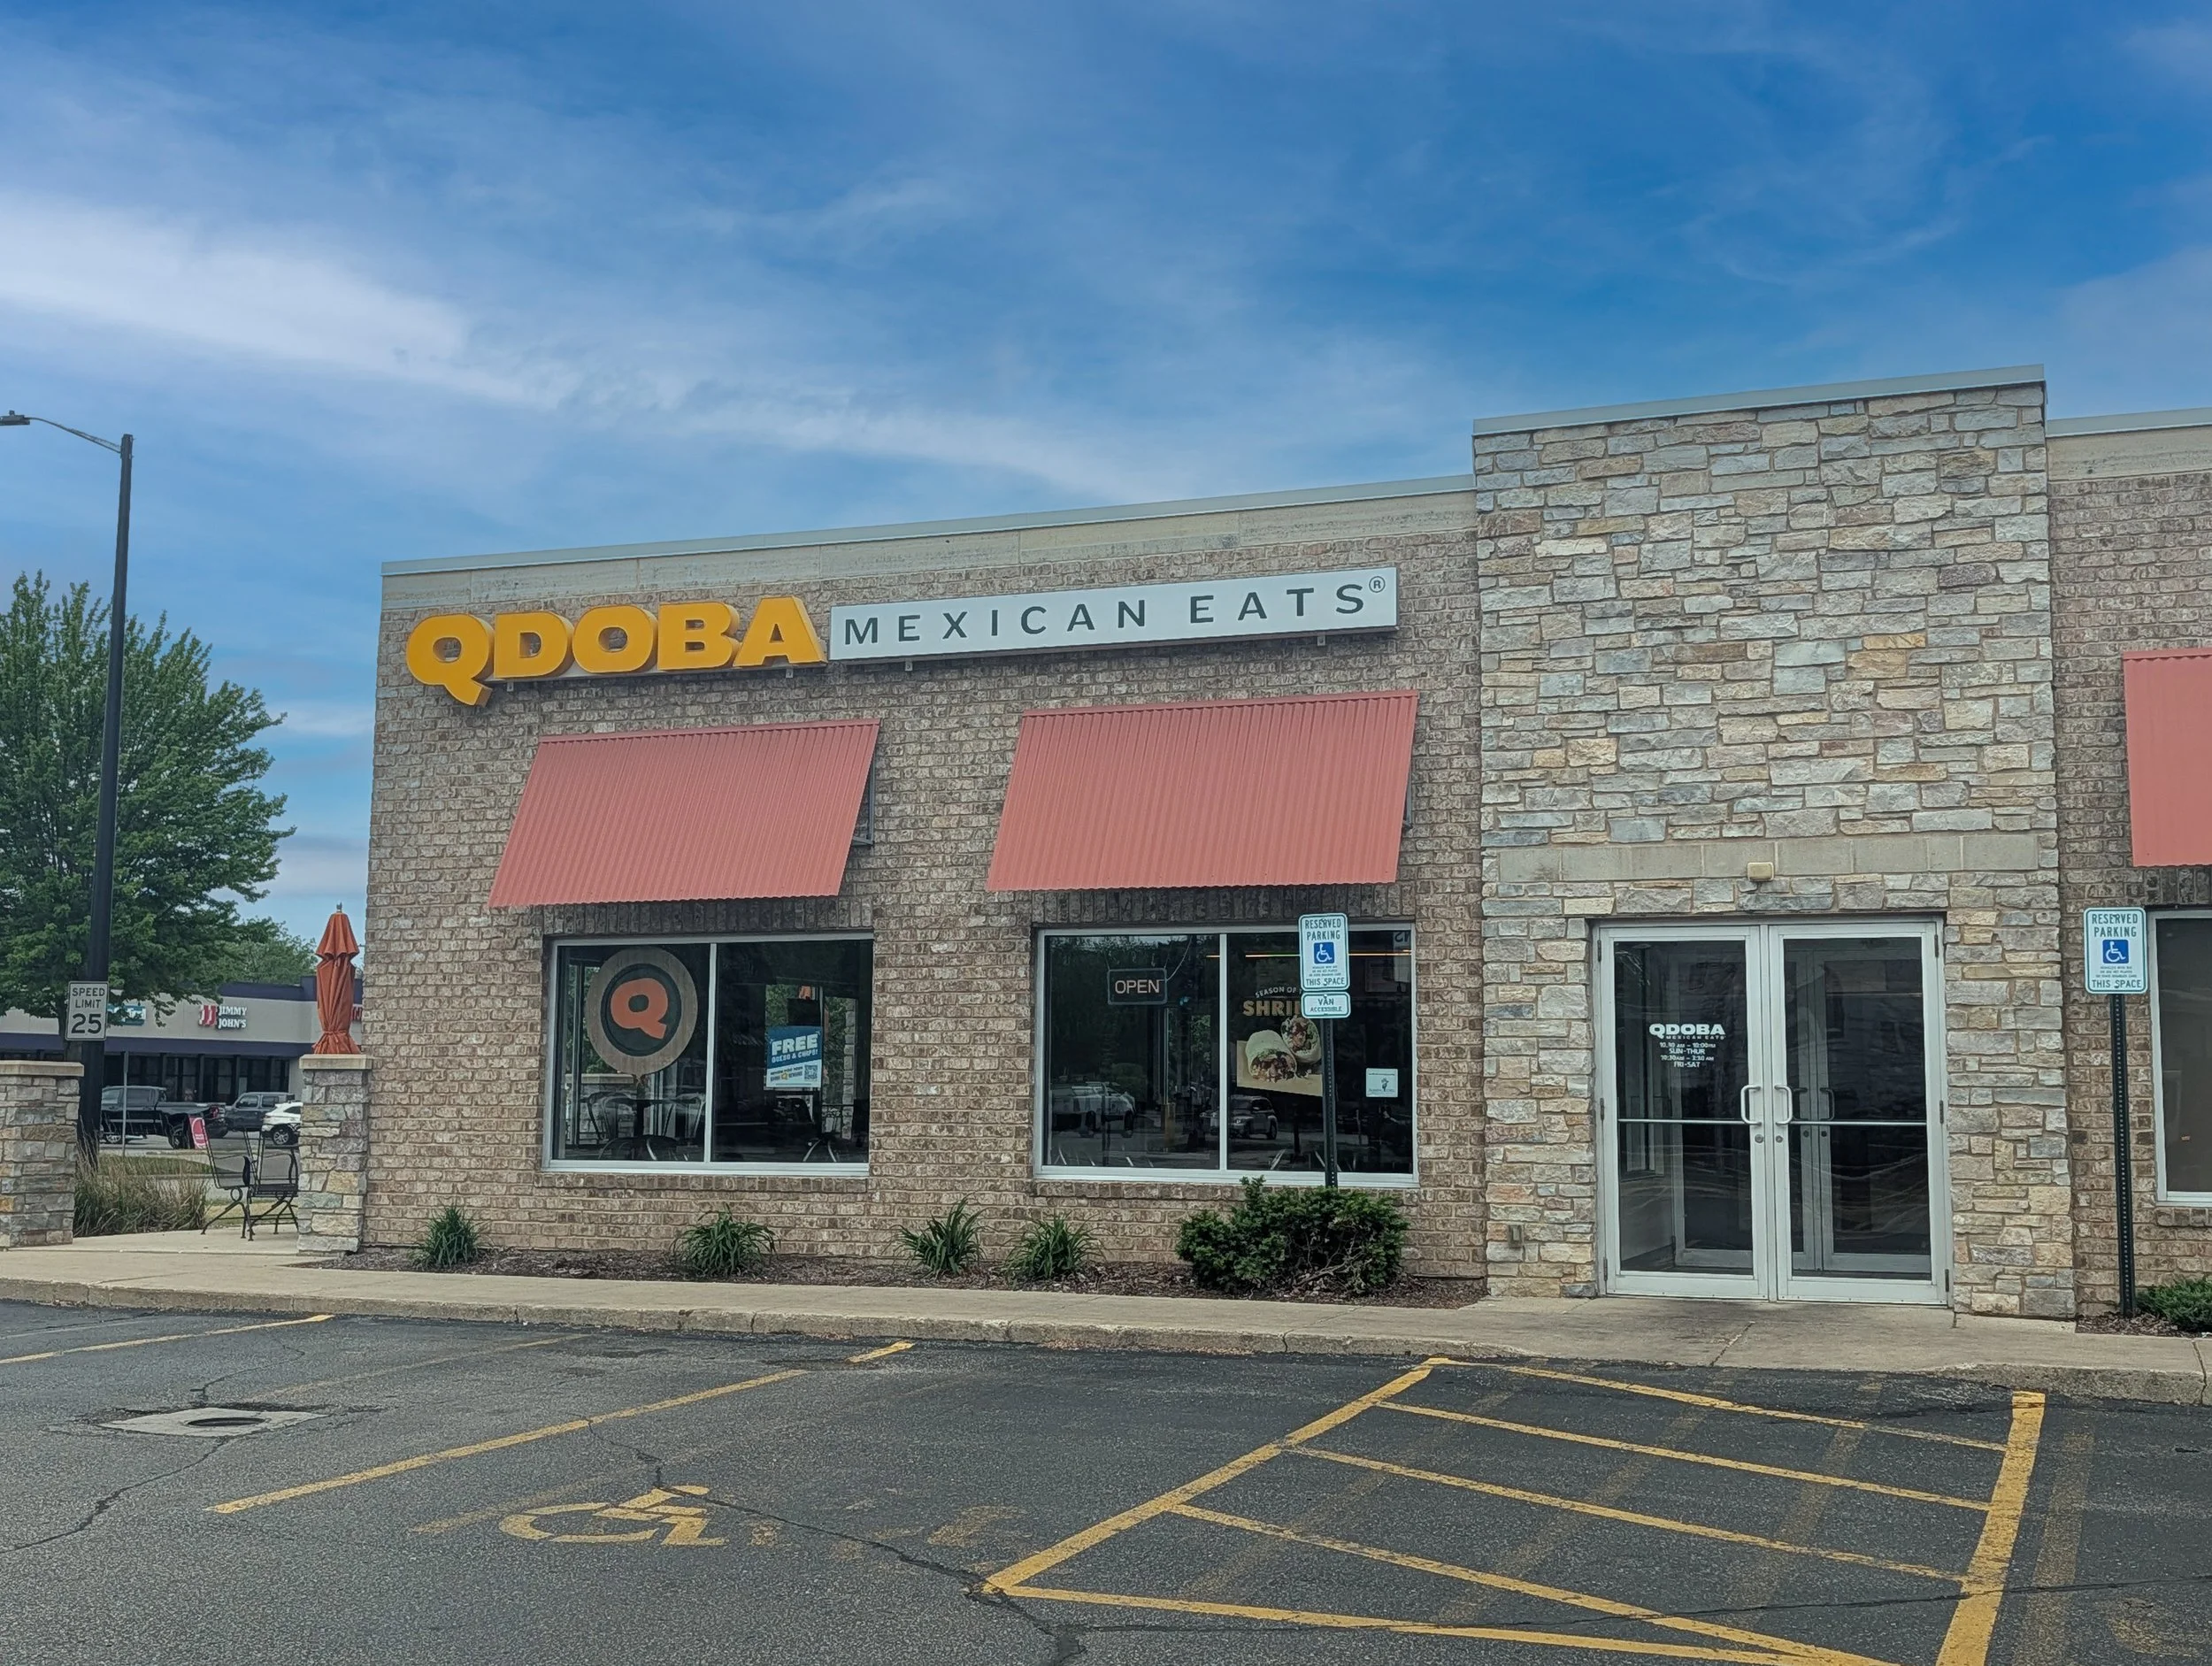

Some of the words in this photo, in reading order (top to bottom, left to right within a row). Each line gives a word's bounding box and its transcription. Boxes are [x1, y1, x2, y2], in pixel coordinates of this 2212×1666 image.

[844, 599, 1147, 645] MEXICAN
[406, 595, 827, 706] QDOBA
[1305, 918, 1341, 929] RESERVED
[2092, 914, 2138, 924] RESERVED
[1307, 930, 1340, 940] PARKING
[2093, 926, 2137, 937] PARKING
[1115, 979, 1160, 994] OPEN
[1324, 977, 1345, 986] SPACE
[2092, 979, 2111, 988] THIS
[2114, 979, 2142, 988] SPACE
[72, 987, 105, 997] SPEED
[1255, 987, 1285, 999] SEASON
[75, 999, 102, 1009] LIMIT
[611, 977, 669, 1040] Q
[1242, 1000, 1301, 1017] SHRI
[218, 1004, 248, 1017] JIMMY
[71, 1013, 102, 1034] 25
[218, 1017, 248, 1029] JOHN'S
[1648, 1023, 1726, 1040] QDOBA
[772, 1033, 818, 1056] FREE
